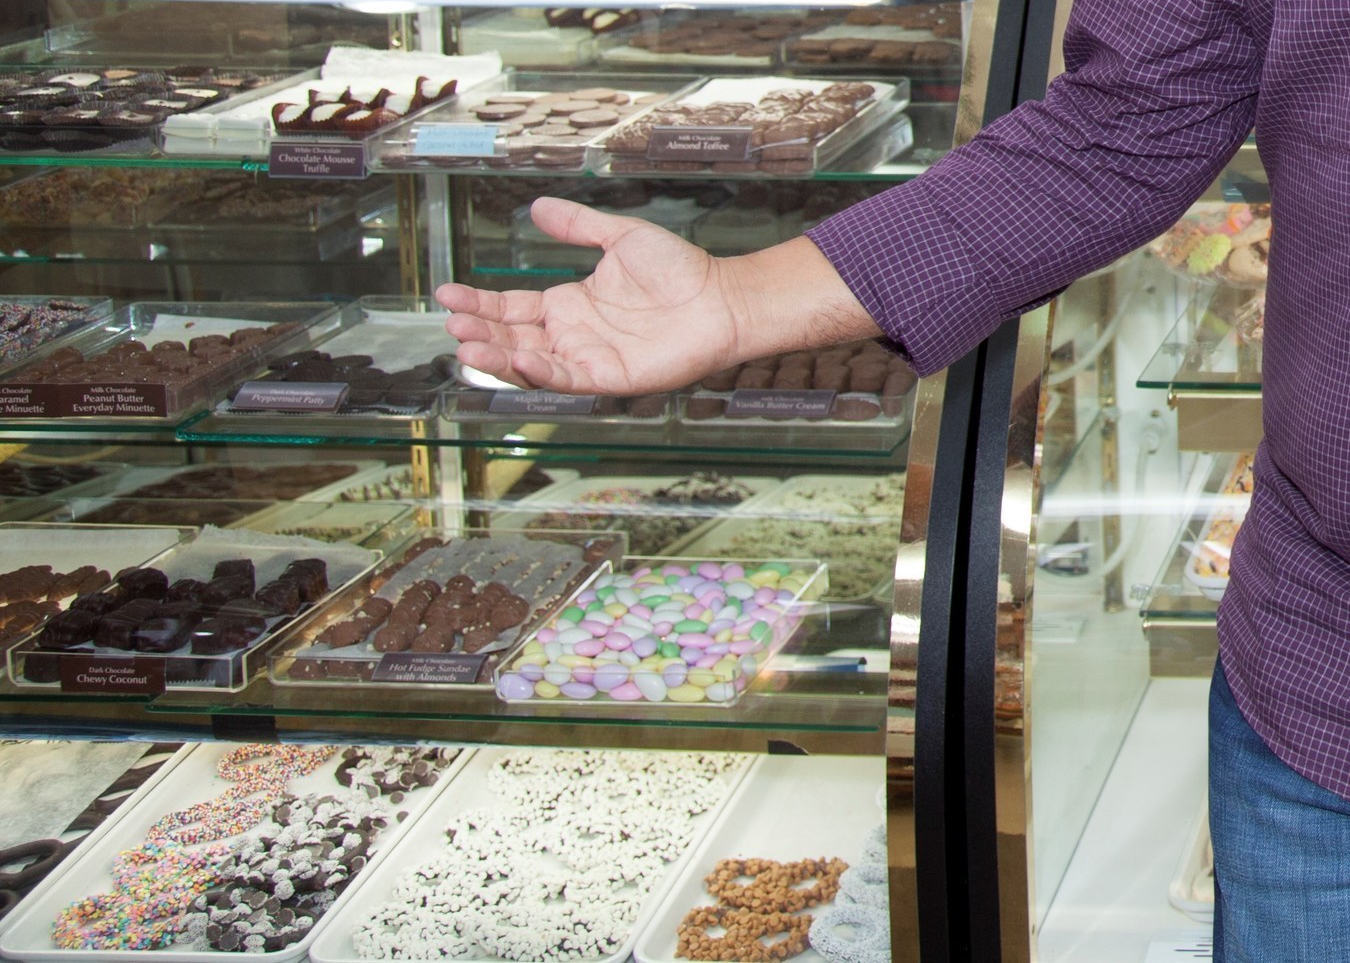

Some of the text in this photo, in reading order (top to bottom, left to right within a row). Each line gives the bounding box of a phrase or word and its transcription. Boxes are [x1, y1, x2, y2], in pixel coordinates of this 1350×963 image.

[666, 141, 730, 150] Almond Toffee
[278, 153, 356, 164] Chocolate Mousse
[303, 164, 330, 173] Truffle
[0, 394, 29, 403] aramel
[83, 394, 144, 403] Peanut Butter
[252, 394, 326, 405] Peppermint Patty
[5, 405, 45, 413] Minuette
[73, 403, 155, 414] Everyday Minuette
[527, 403, 557, 411] Cream
[736, 400, 764, 408] Vanilla
[766, 401, 793, 409] Butter
[389, 664, 471, 673] Hot Fudge Sundae
[76, 674, 148, 686] Chewy Coconut
[396, 673, 457, 682] with Almonds
